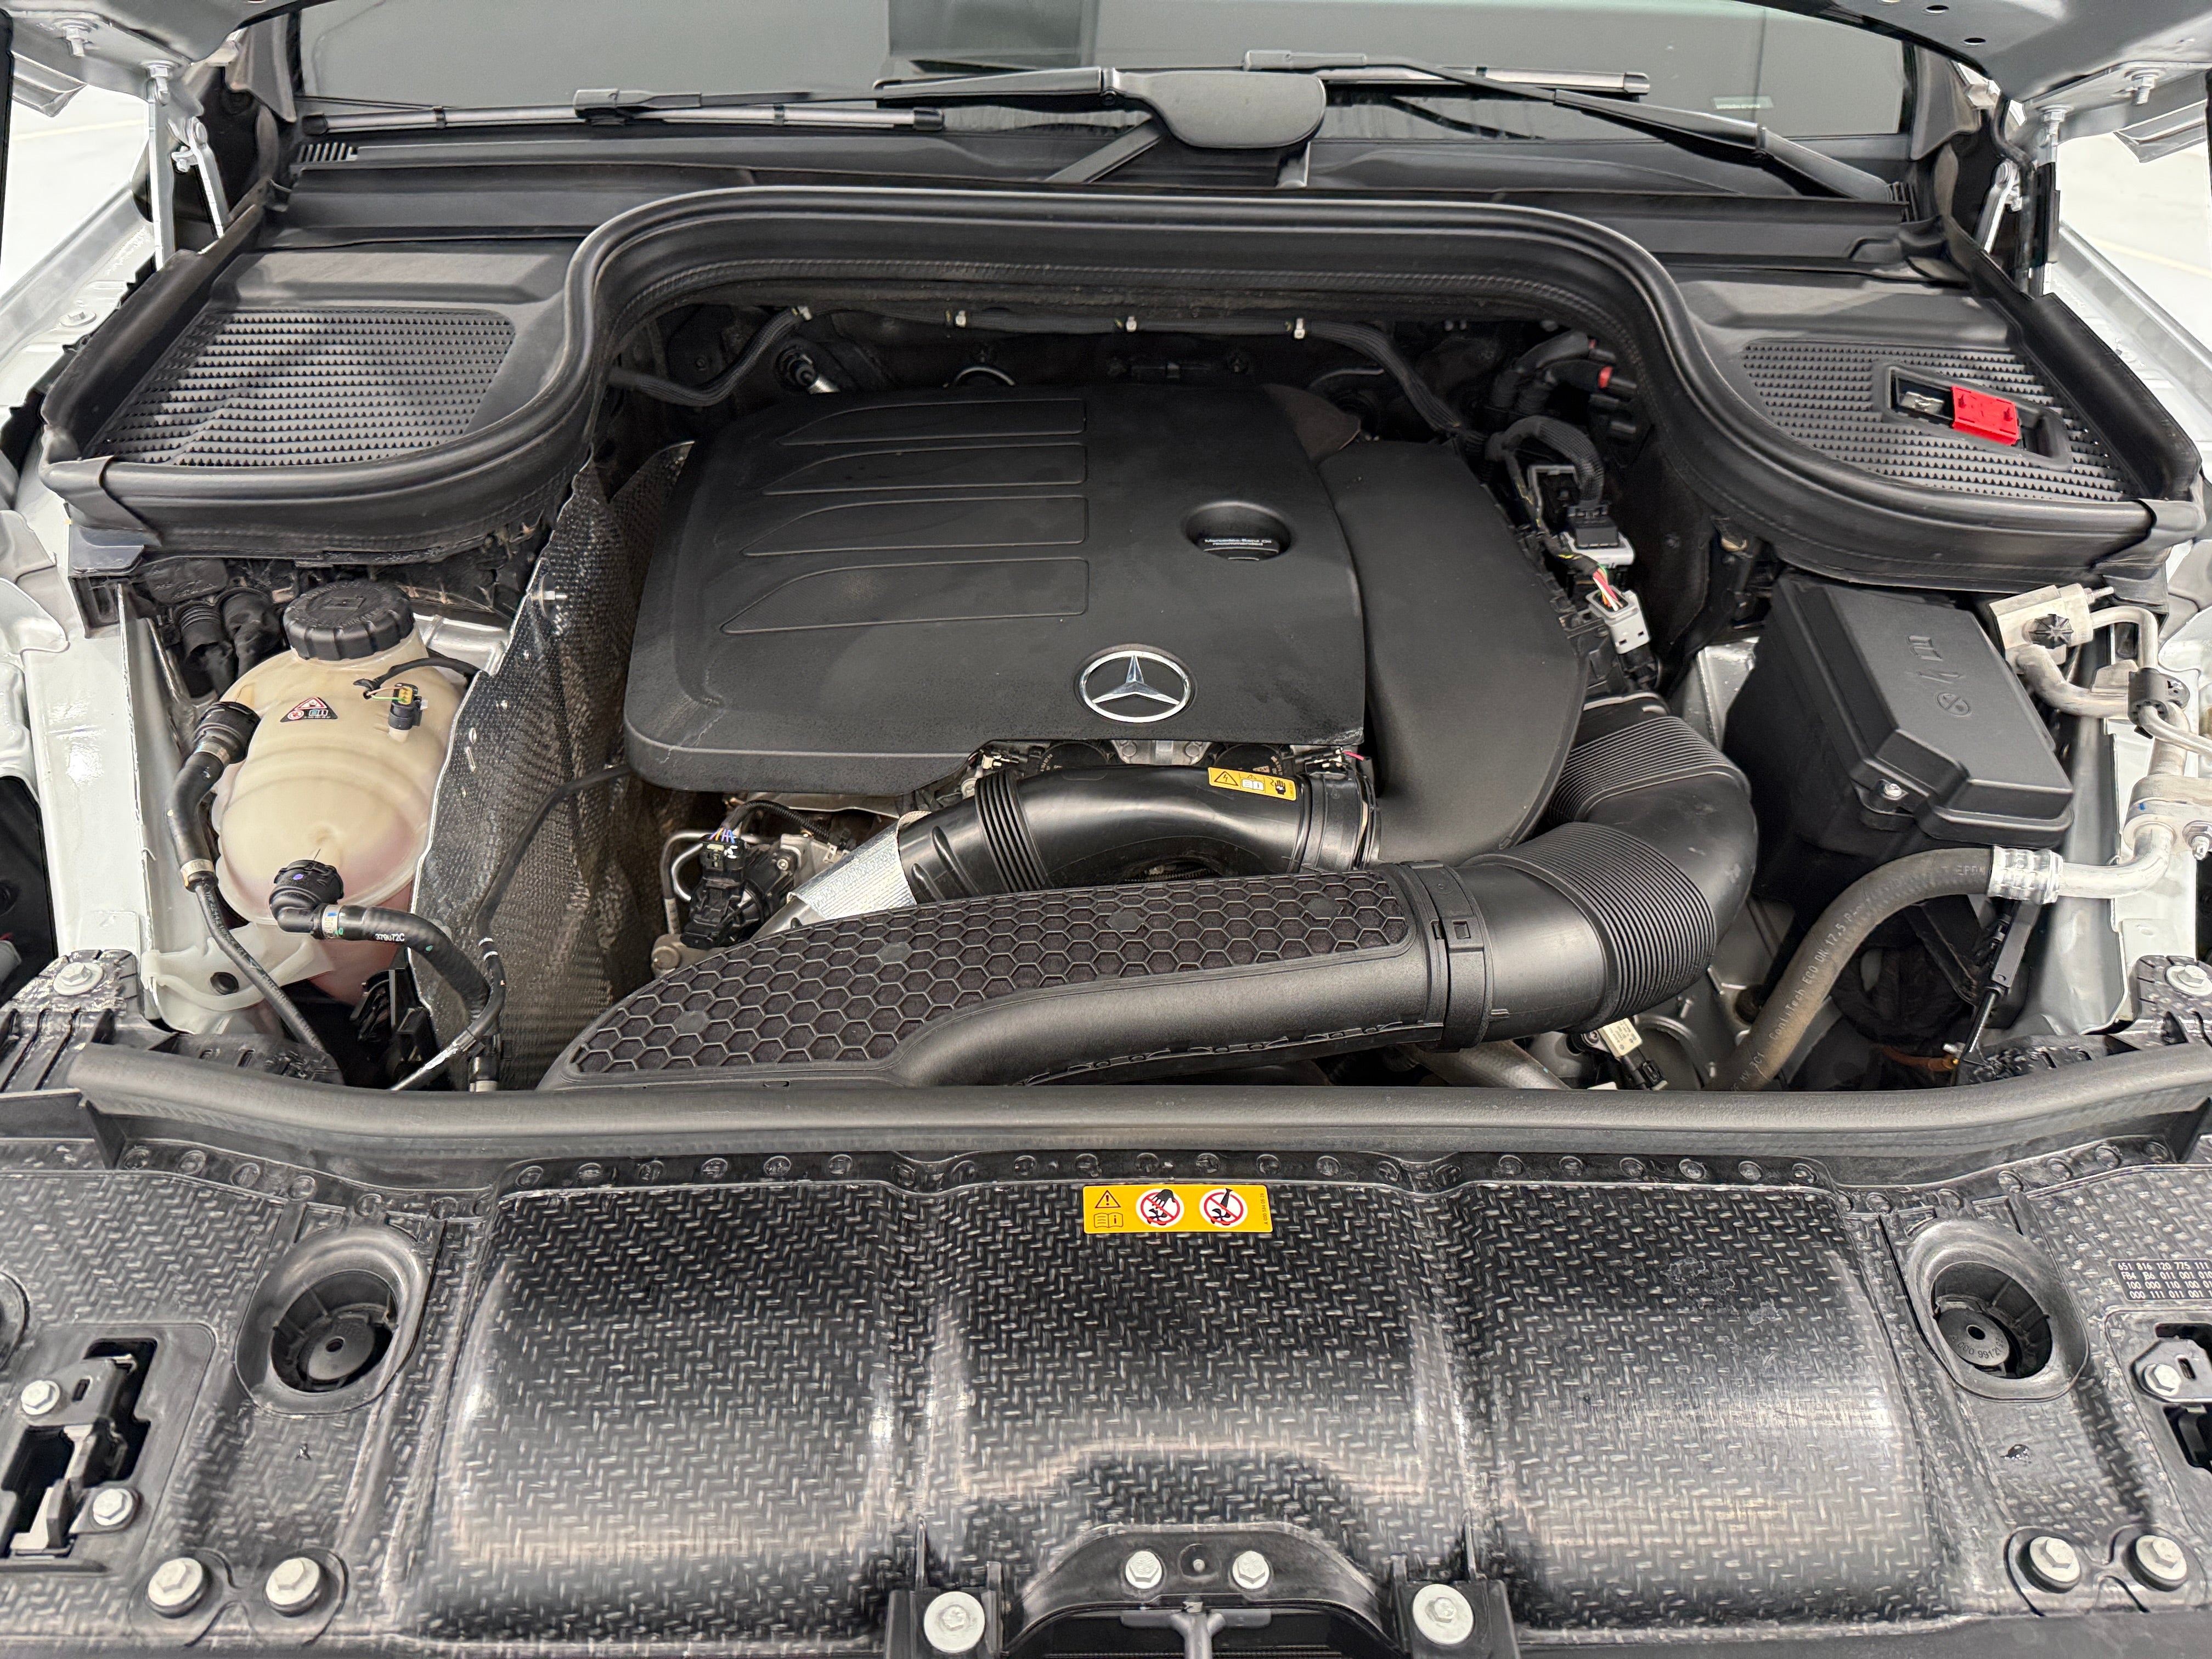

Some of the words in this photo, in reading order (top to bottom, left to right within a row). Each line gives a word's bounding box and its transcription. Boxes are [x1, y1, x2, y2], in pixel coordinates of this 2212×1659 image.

[1802, 965, 1819, 985] ECO
[2118, 1262, 2133, 1271] 651
[2136, 1262, 2152, 1271] 816
[2156, 1262, 2171, 1271] 120
[2174, 1261, 2191, 1270] 775
[2194, 1262, 2210, 1270] 111
[2160, 1271, 2176, 1280] 011
[2179, 1271, 2195, 1280] 001
[2126, 1281, 2142, 1289] 100
[2145, 1281, 2161, 1289] 000
[2165, 1280, 2181, 1289] 110
[2184, 1280, 2200, 1289] 100
[2129, 1290, 2146, 1299] 000
[2150, 1290, 2165, 1299] 111
[2169, 1290, 2185, 1299] 011
[2188, 1290, 2204, 1298] 001
[1978, 1350, 1994, 1359] 991
